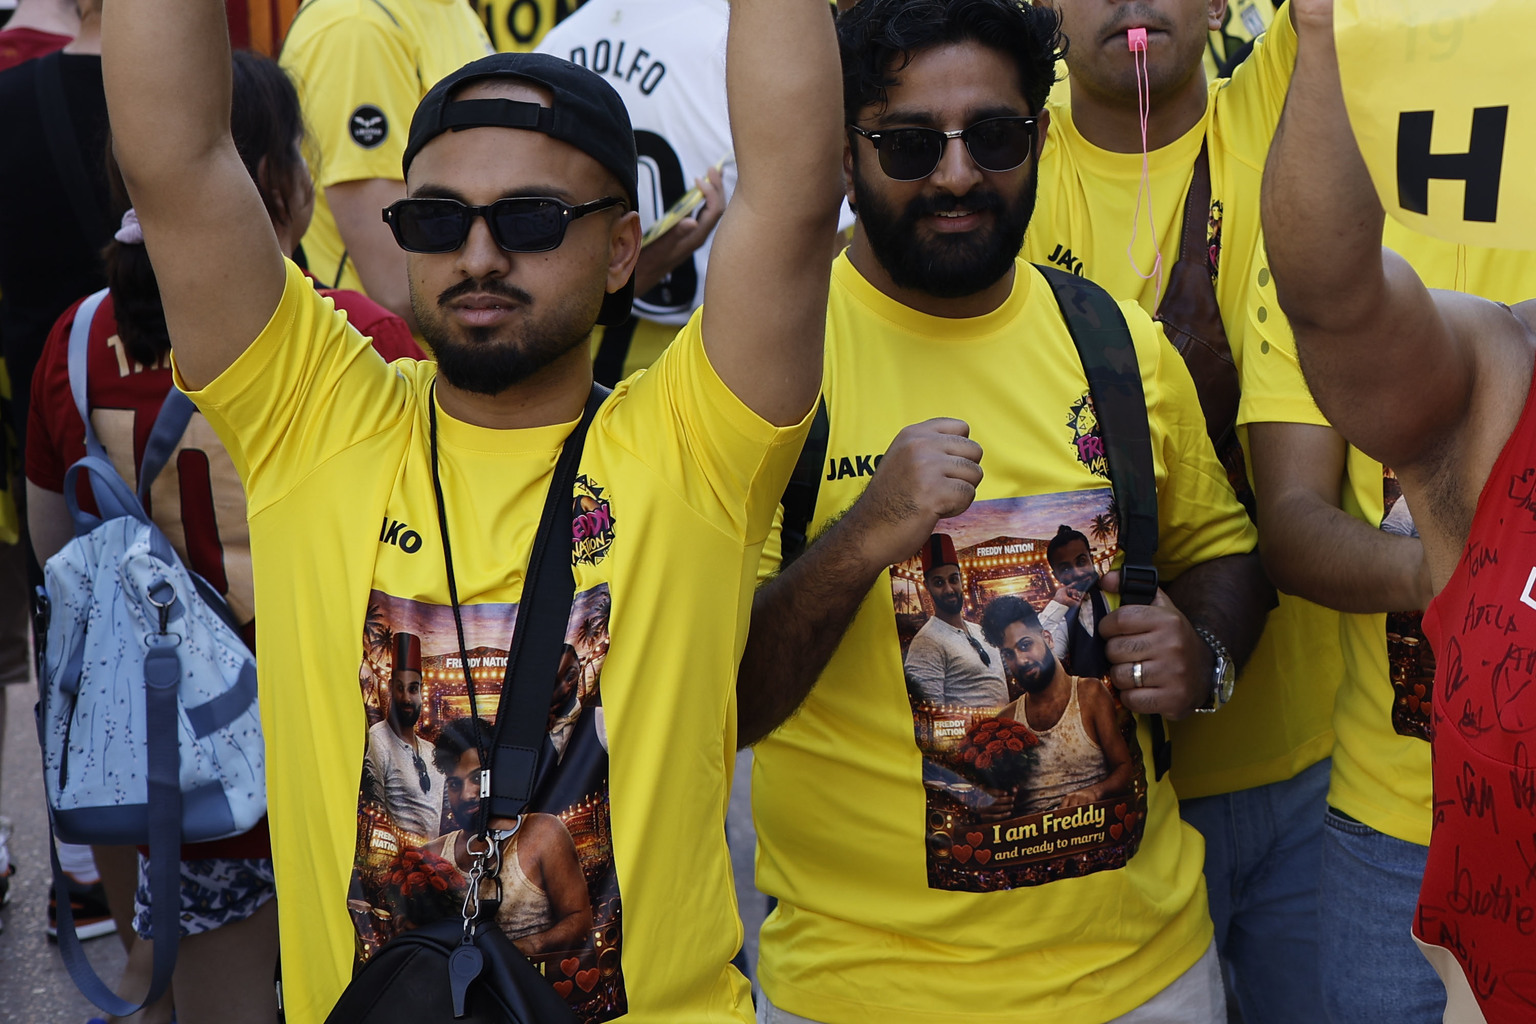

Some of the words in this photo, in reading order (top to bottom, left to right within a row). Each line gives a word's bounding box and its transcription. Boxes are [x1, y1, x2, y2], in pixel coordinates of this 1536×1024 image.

[977, 546, 1003, 557] FREDDY
[1003, 542, 1034, 554] NATION
[934, 719, 965, 728] FREDDY
[935, 728, 966, 736] NATION
[992, 824, 1002, 844] I
[1005, 822, 1039, 841] am
[1042, 804, 1106, 835] Freddy
[994, 846, 1019, 860] and
[1021, 841, 1055, 857] ready
[1056, 837, 1068, 849] to
[1070, 830, 1105, 847] marry
